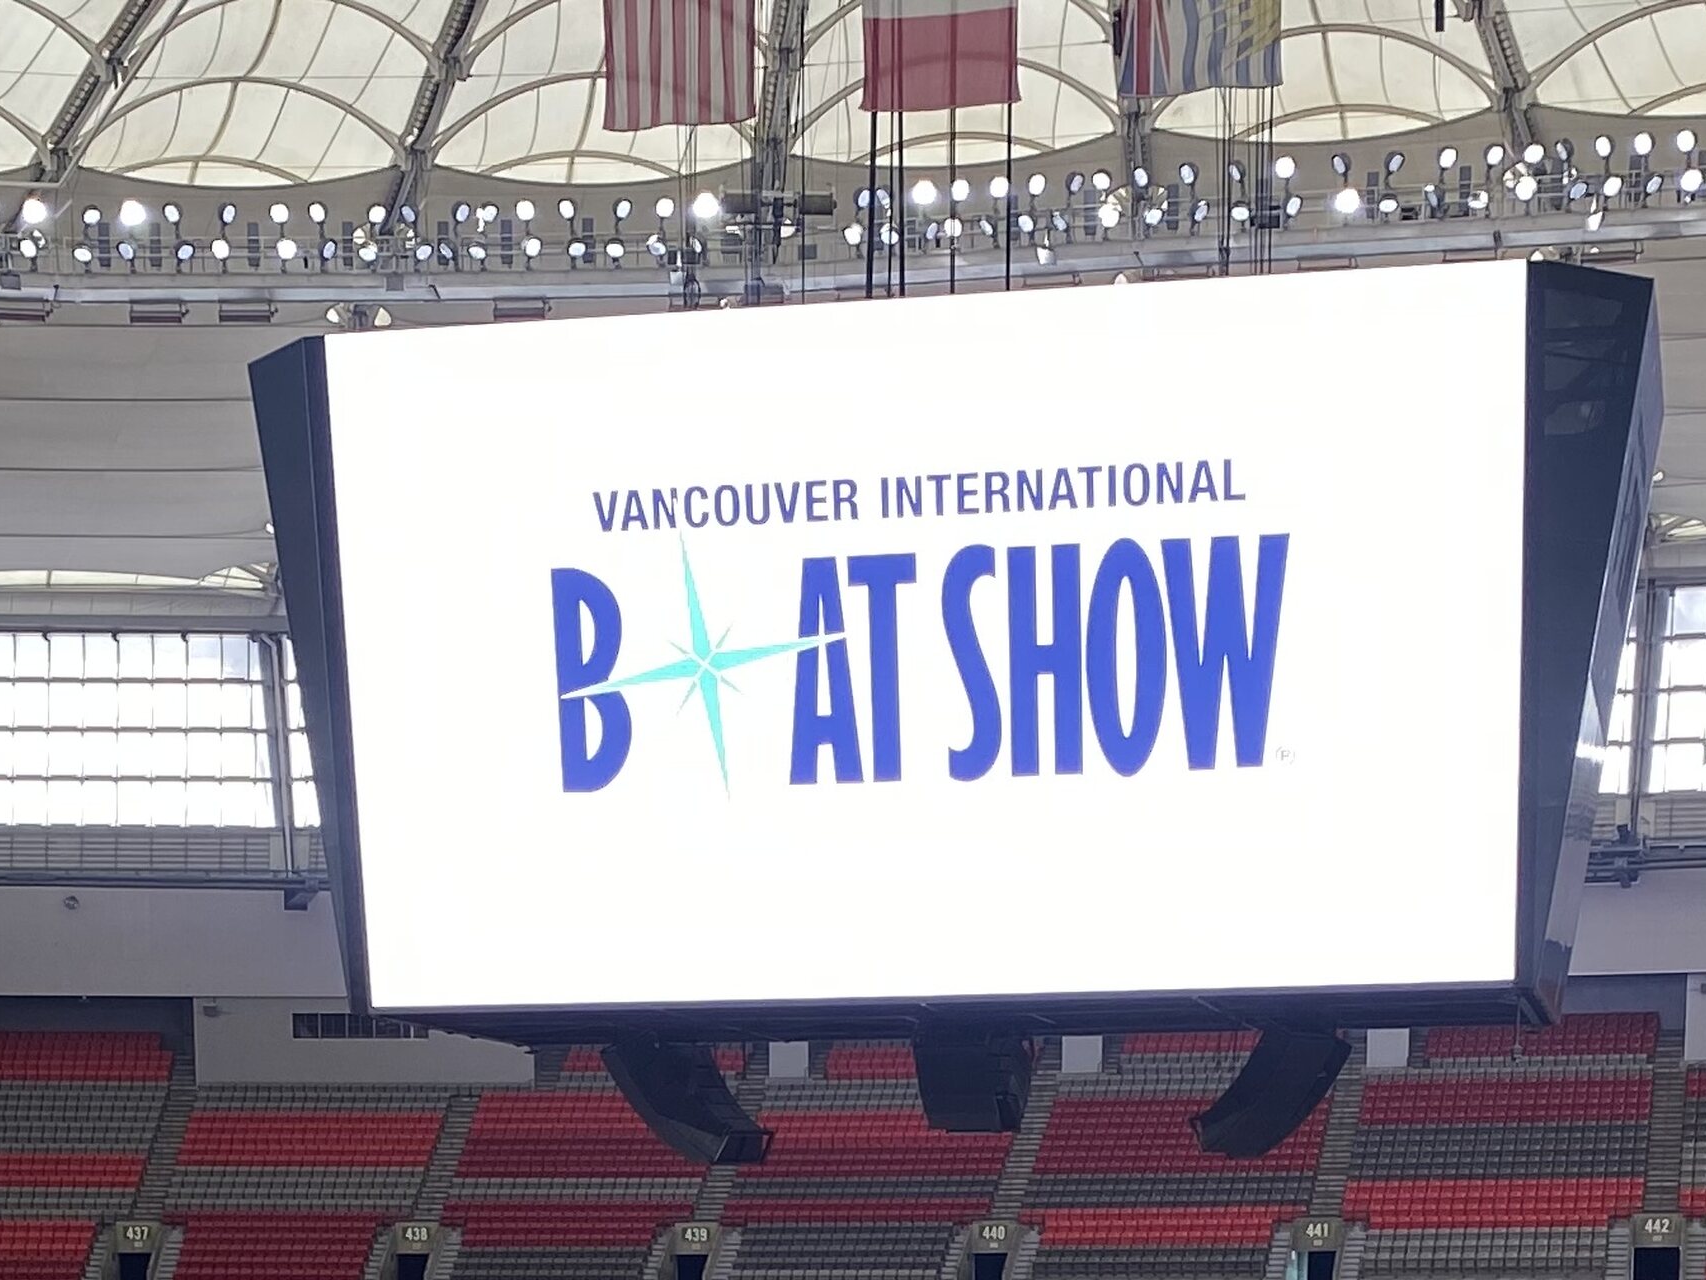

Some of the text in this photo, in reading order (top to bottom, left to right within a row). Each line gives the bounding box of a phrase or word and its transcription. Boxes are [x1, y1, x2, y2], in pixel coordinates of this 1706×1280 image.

[591, 458, 1247, 533] VANCOUVER INTERNATIONAL
[940, 532, 1291, 784] SHOW
[126, 1226, 148, 1240] 437
[983, 1226, 1005, 1240] 440
[1306, 1223, 1329, 1238] 441
[1644, 1219, 1670, 1233] 442
[405, 1228, 428, 1241] 438
[684, 1228, 708, 1241] 439
